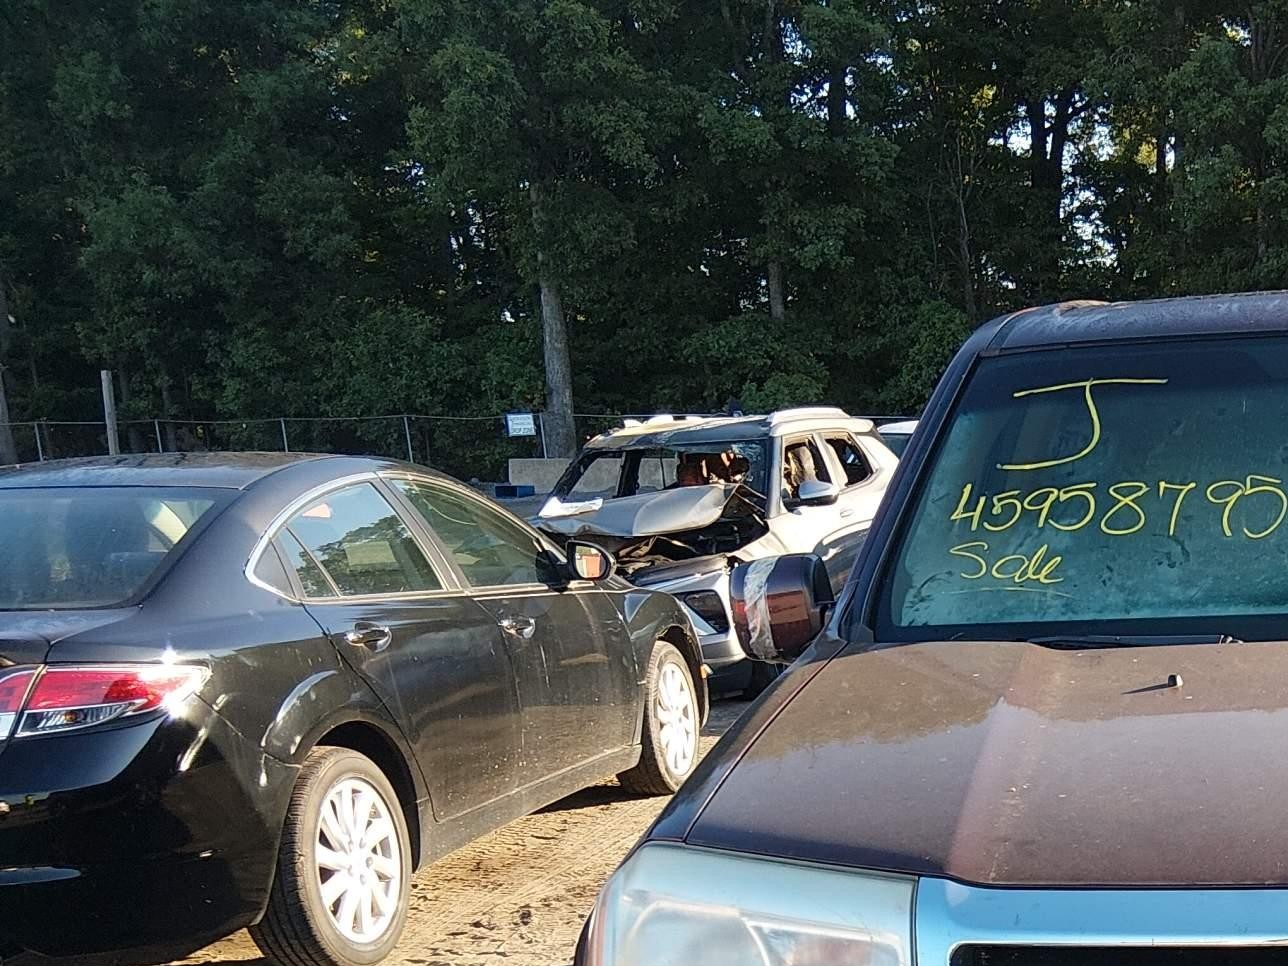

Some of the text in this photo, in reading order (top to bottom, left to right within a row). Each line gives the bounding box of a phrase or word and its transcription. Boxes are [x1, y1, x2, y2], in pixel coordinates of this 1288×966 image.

[996, 377, 1169, 470] J
[950, 474, 1288, 540] 45958795
[949, 541, 1064, 585] Sale
